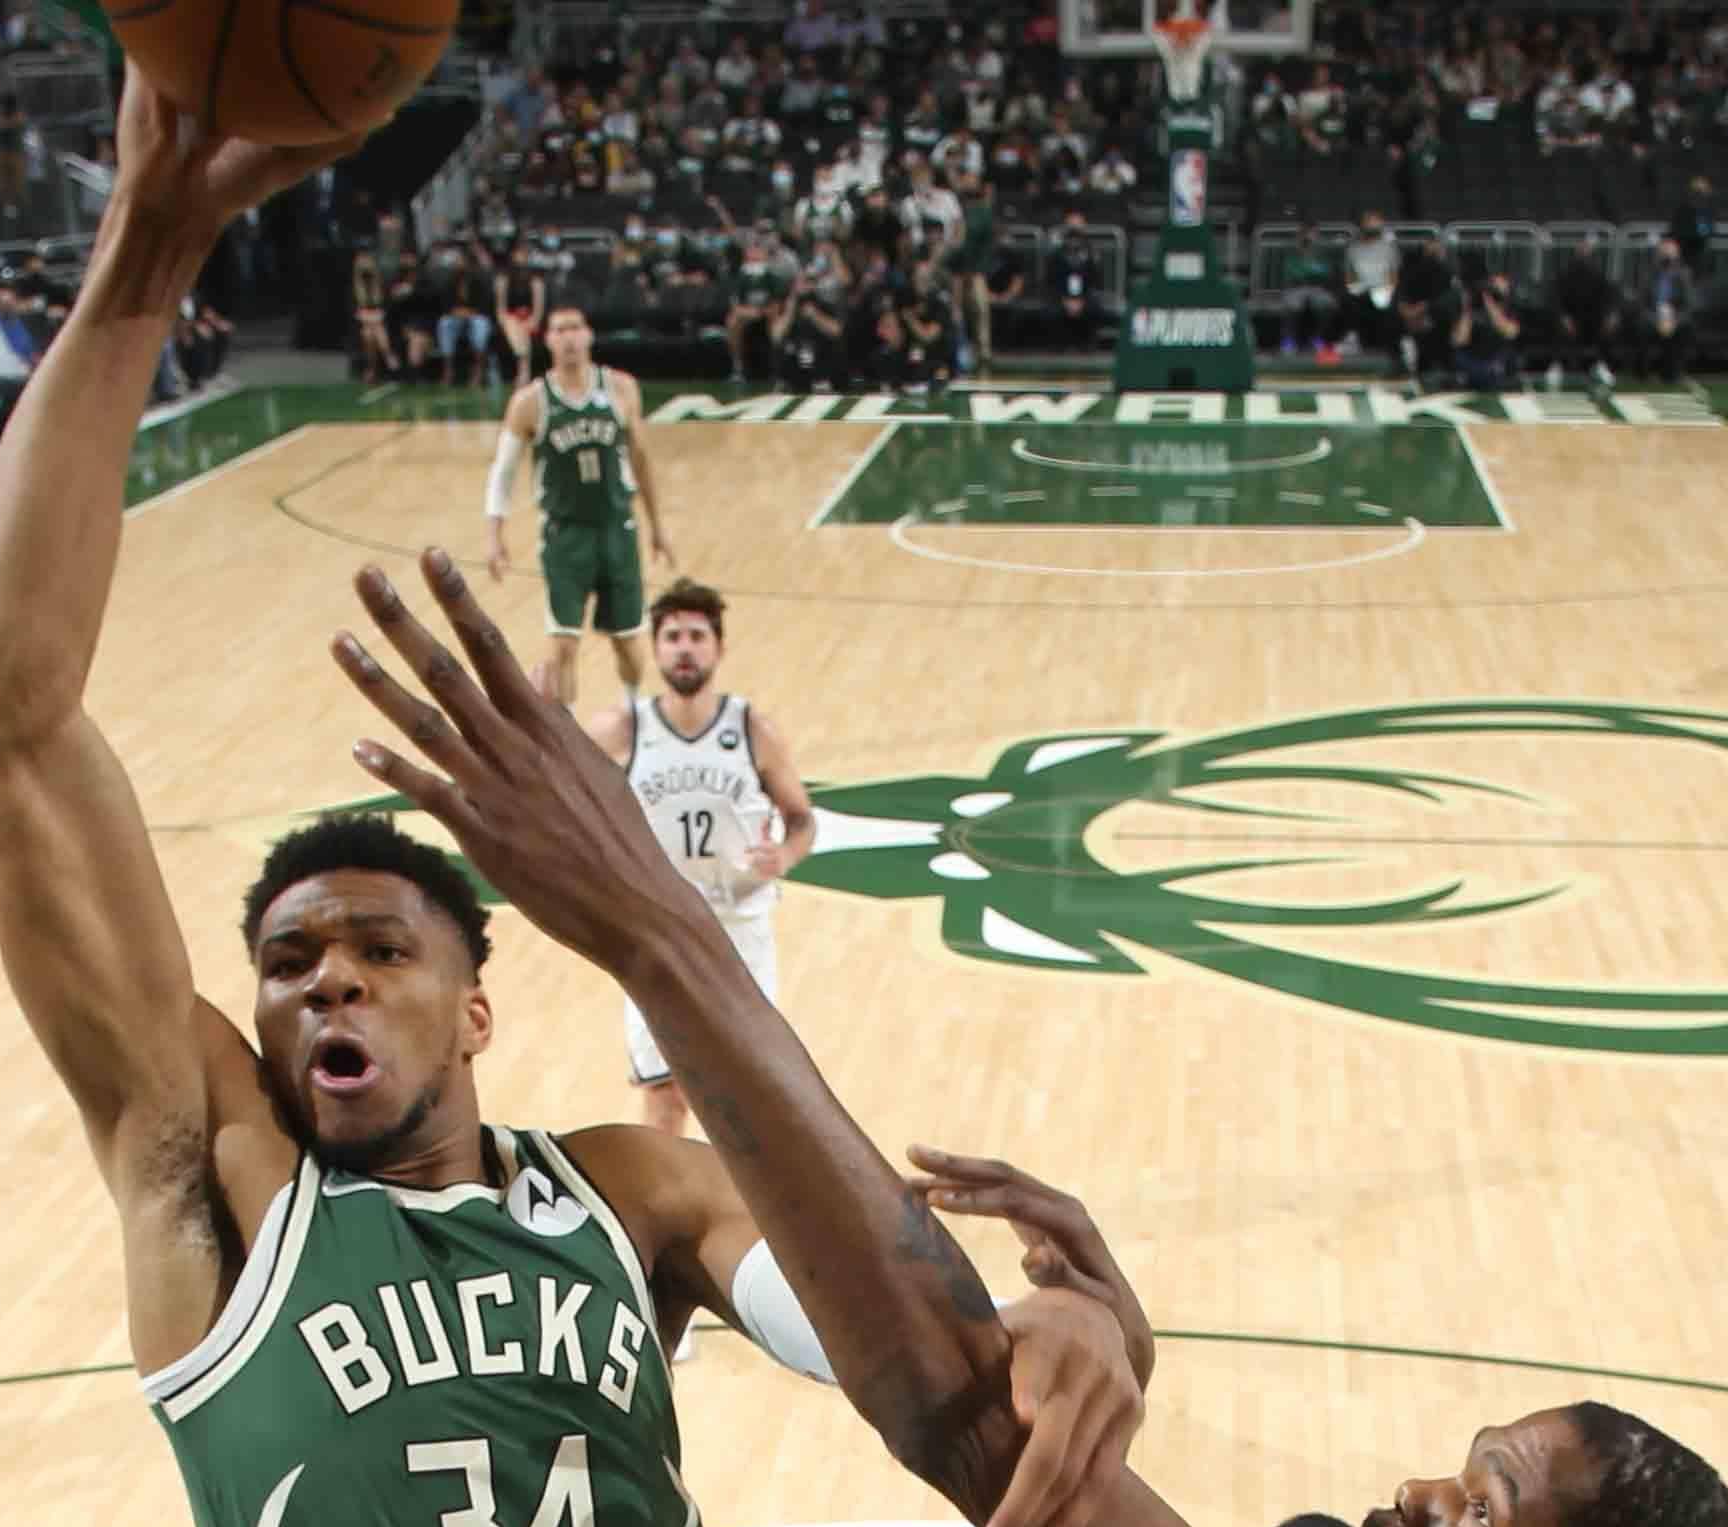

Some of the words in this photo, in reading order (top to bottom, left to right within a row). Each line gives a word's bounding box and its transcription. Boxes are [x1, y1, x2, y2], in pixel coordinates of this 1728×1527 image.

[647, 391, 1726, 427] MILWAUKEE
[638, 765, 746, 806] BROOKLYN
[678, 810, 716, 859] 12
[298, 1271, 651, 1416] BUCKS
